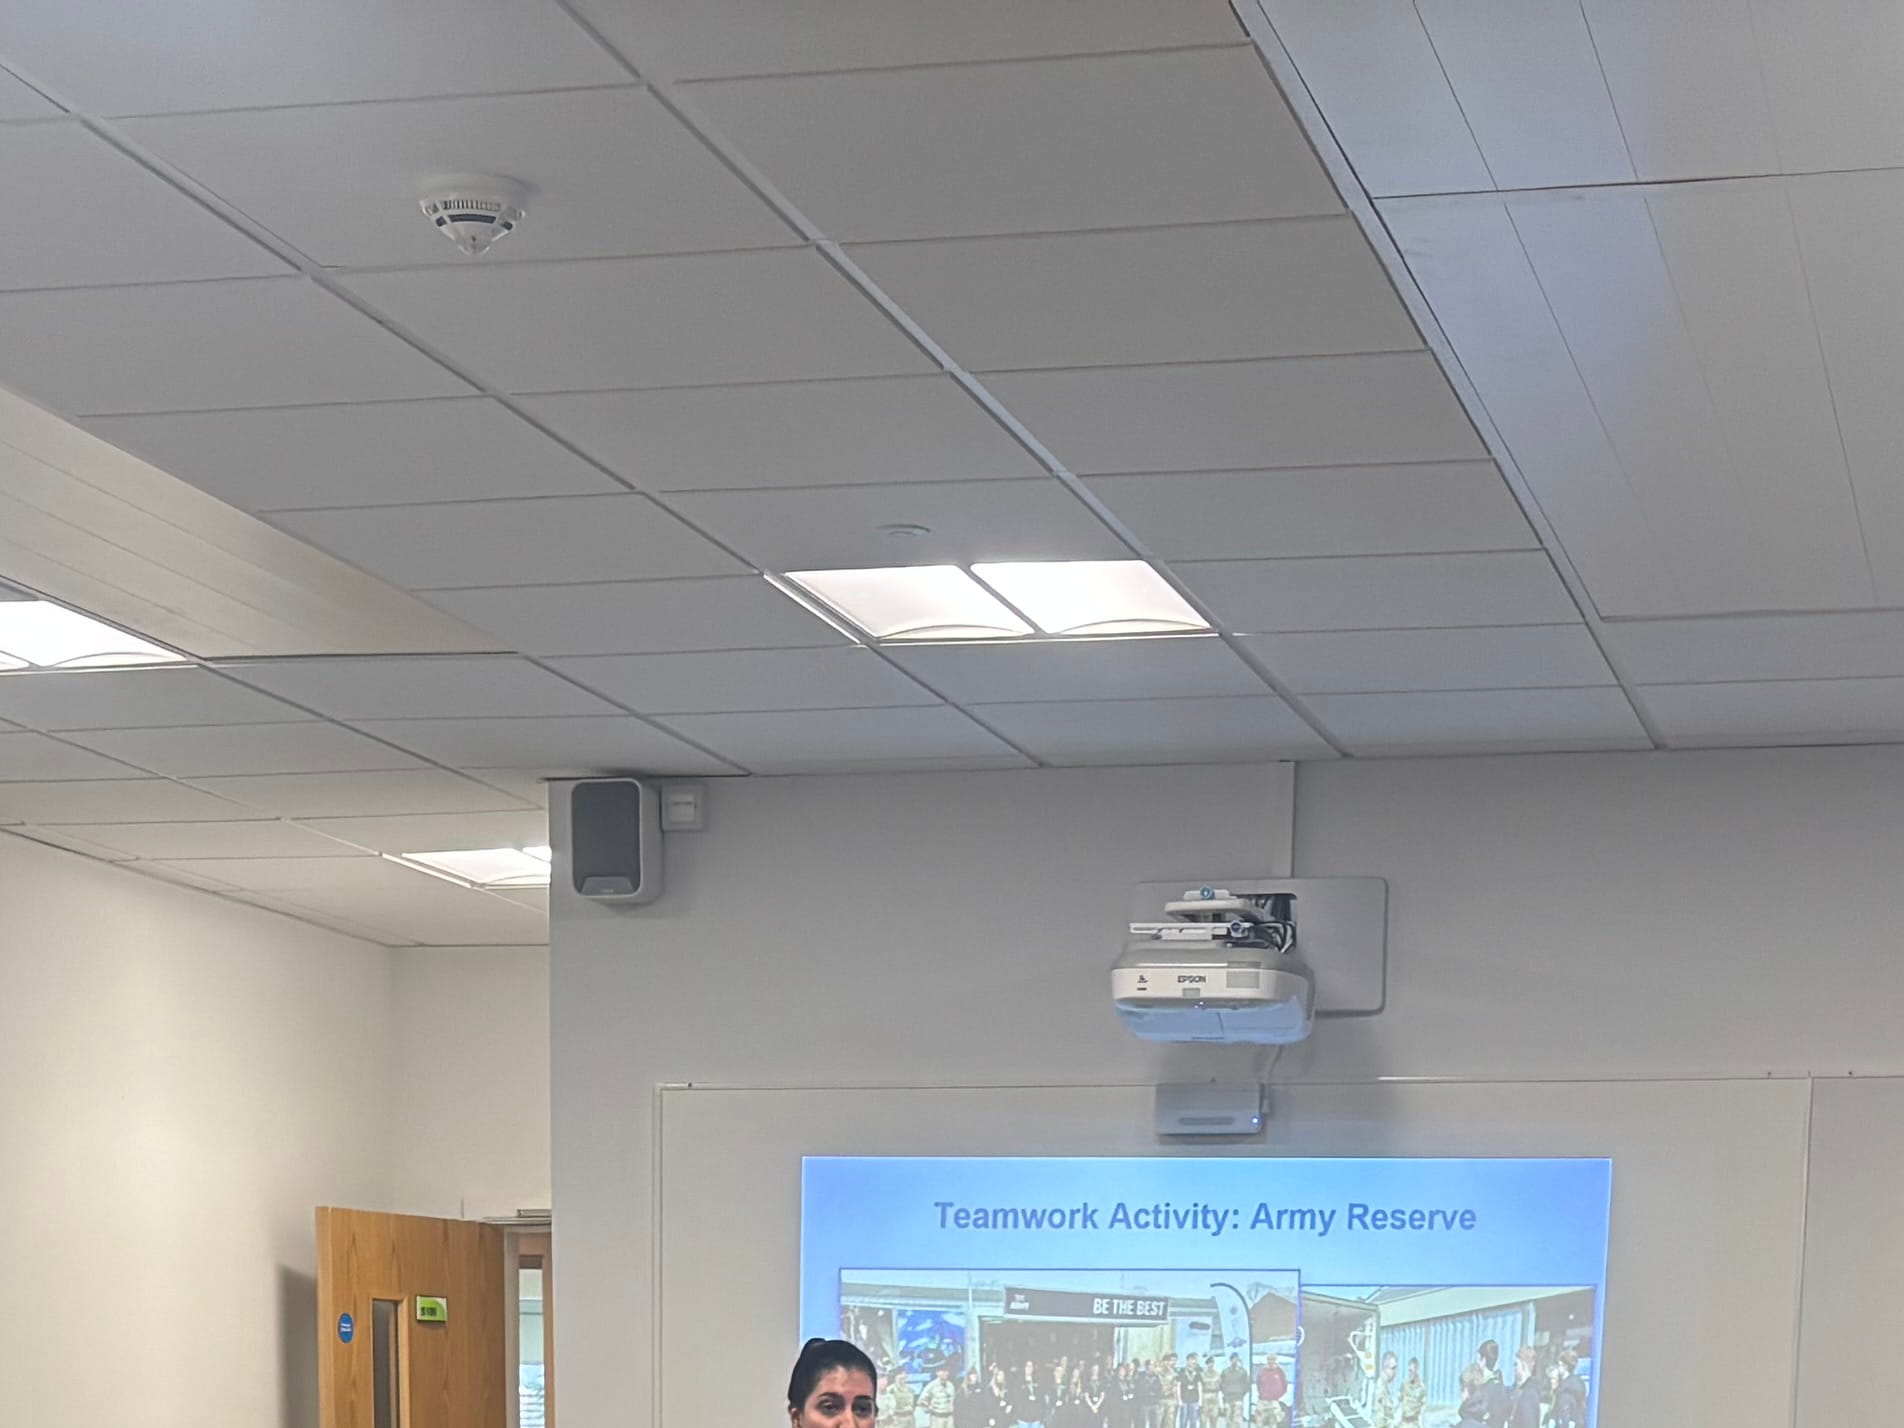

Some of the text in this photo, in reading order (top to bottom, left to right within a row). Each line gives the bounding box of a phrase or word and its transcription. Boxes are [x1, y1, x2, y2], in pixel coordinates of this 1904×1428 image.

[1177, 975, 1207, 984] EPSON
[934, 1202, 1478, 1238] Teamwork Activity: Army Reserve
[1093, 1298, 1166, 1317] BE THE BEST
